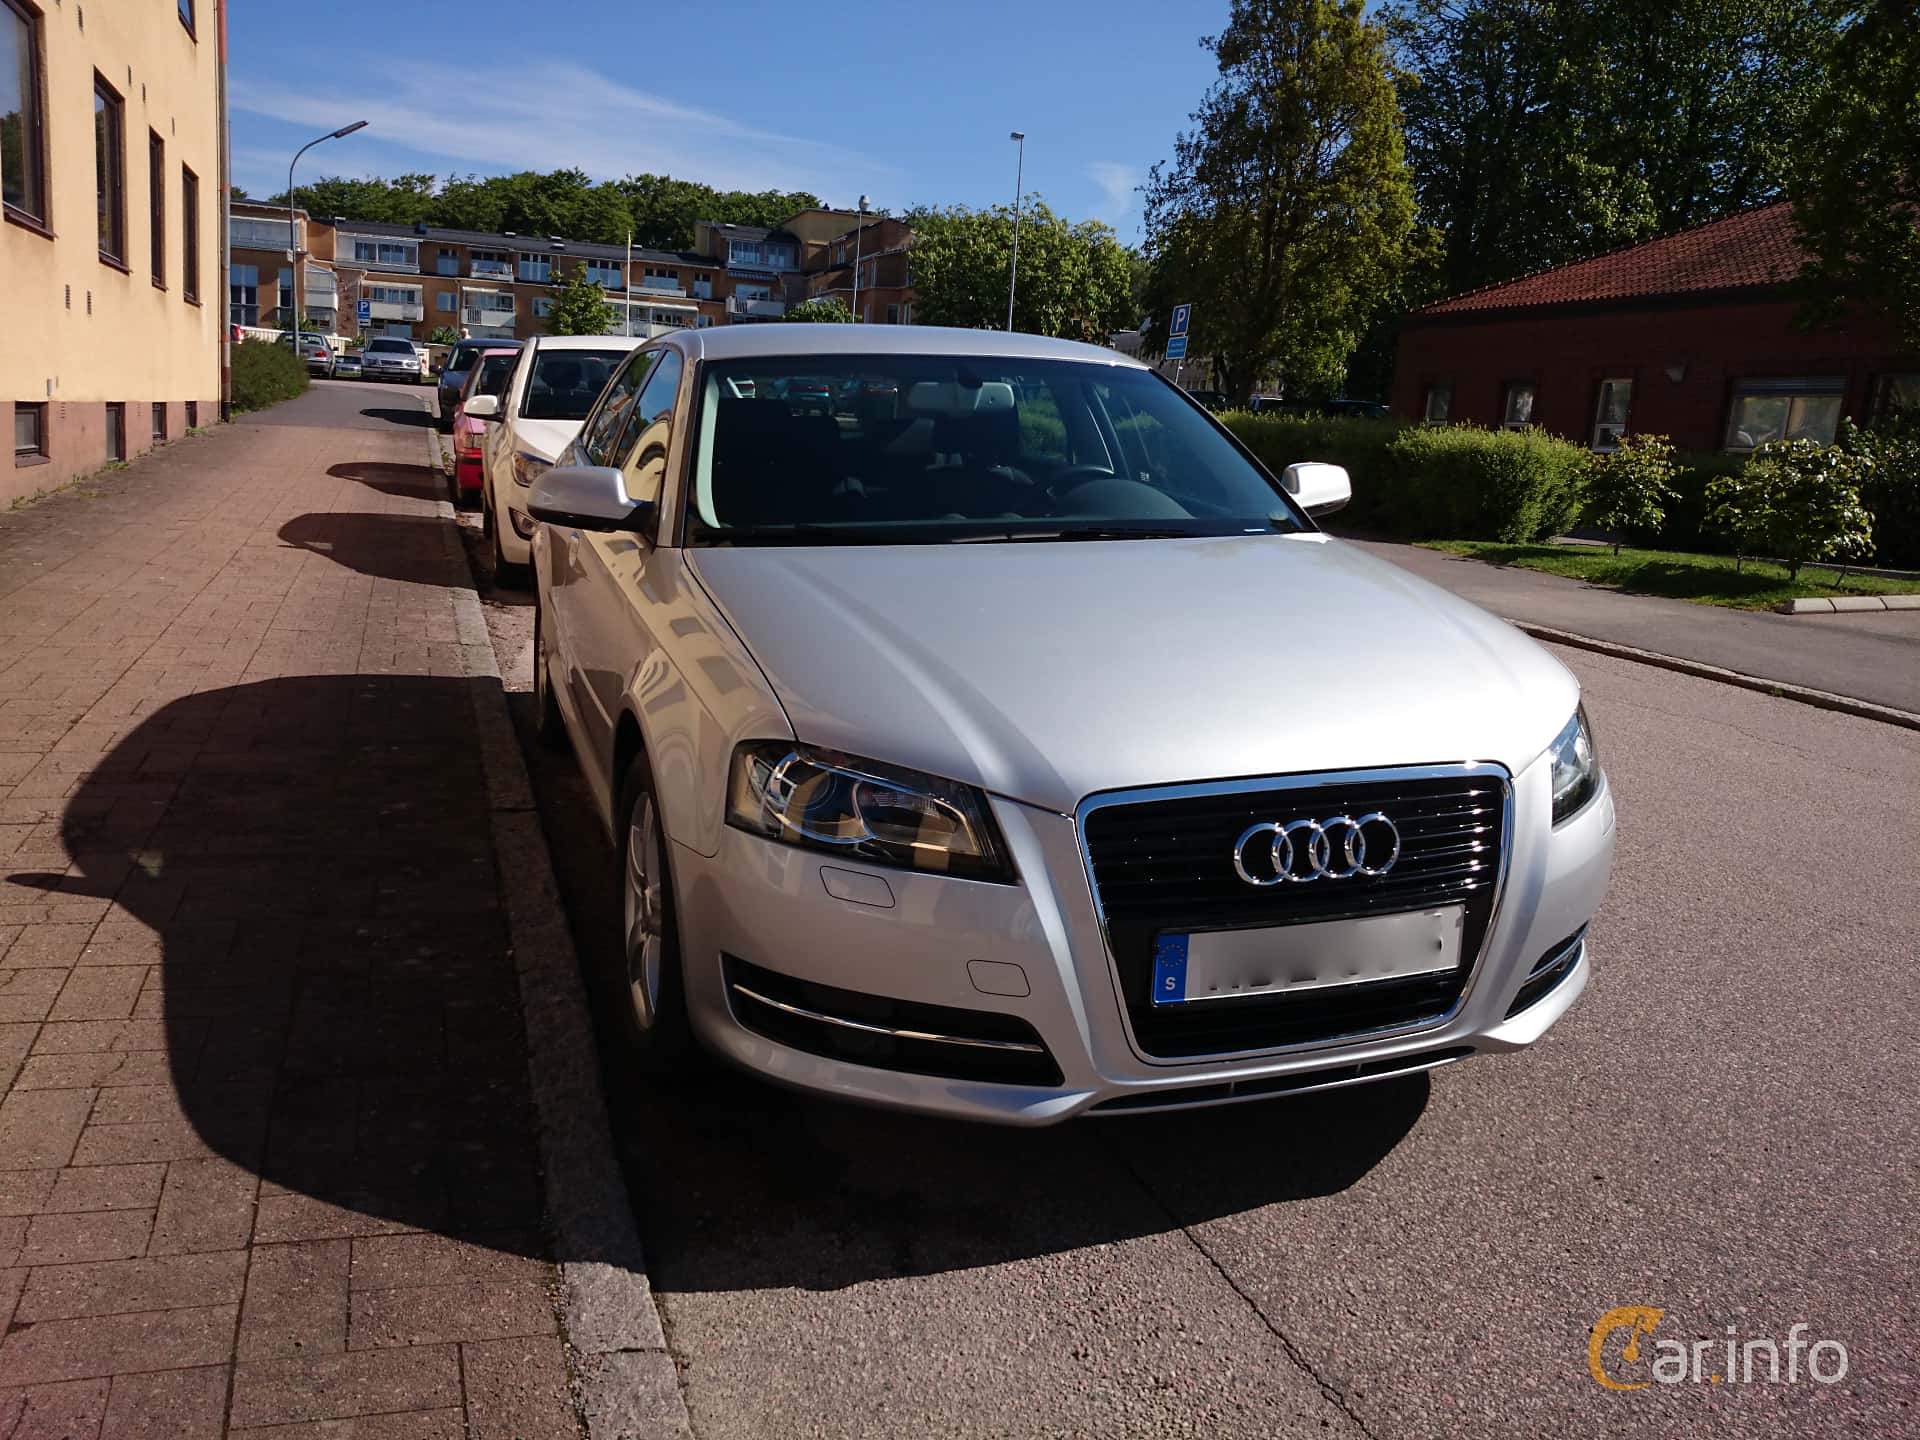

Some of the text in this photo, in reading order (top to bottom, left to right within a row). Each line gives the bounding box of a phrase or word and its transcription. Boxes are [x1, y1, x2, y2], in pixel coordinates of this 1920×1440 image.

[361, 302, 368, 312] P
[1176, 309, 1186, 331] P
[1165, 976, 1176, 991] S
